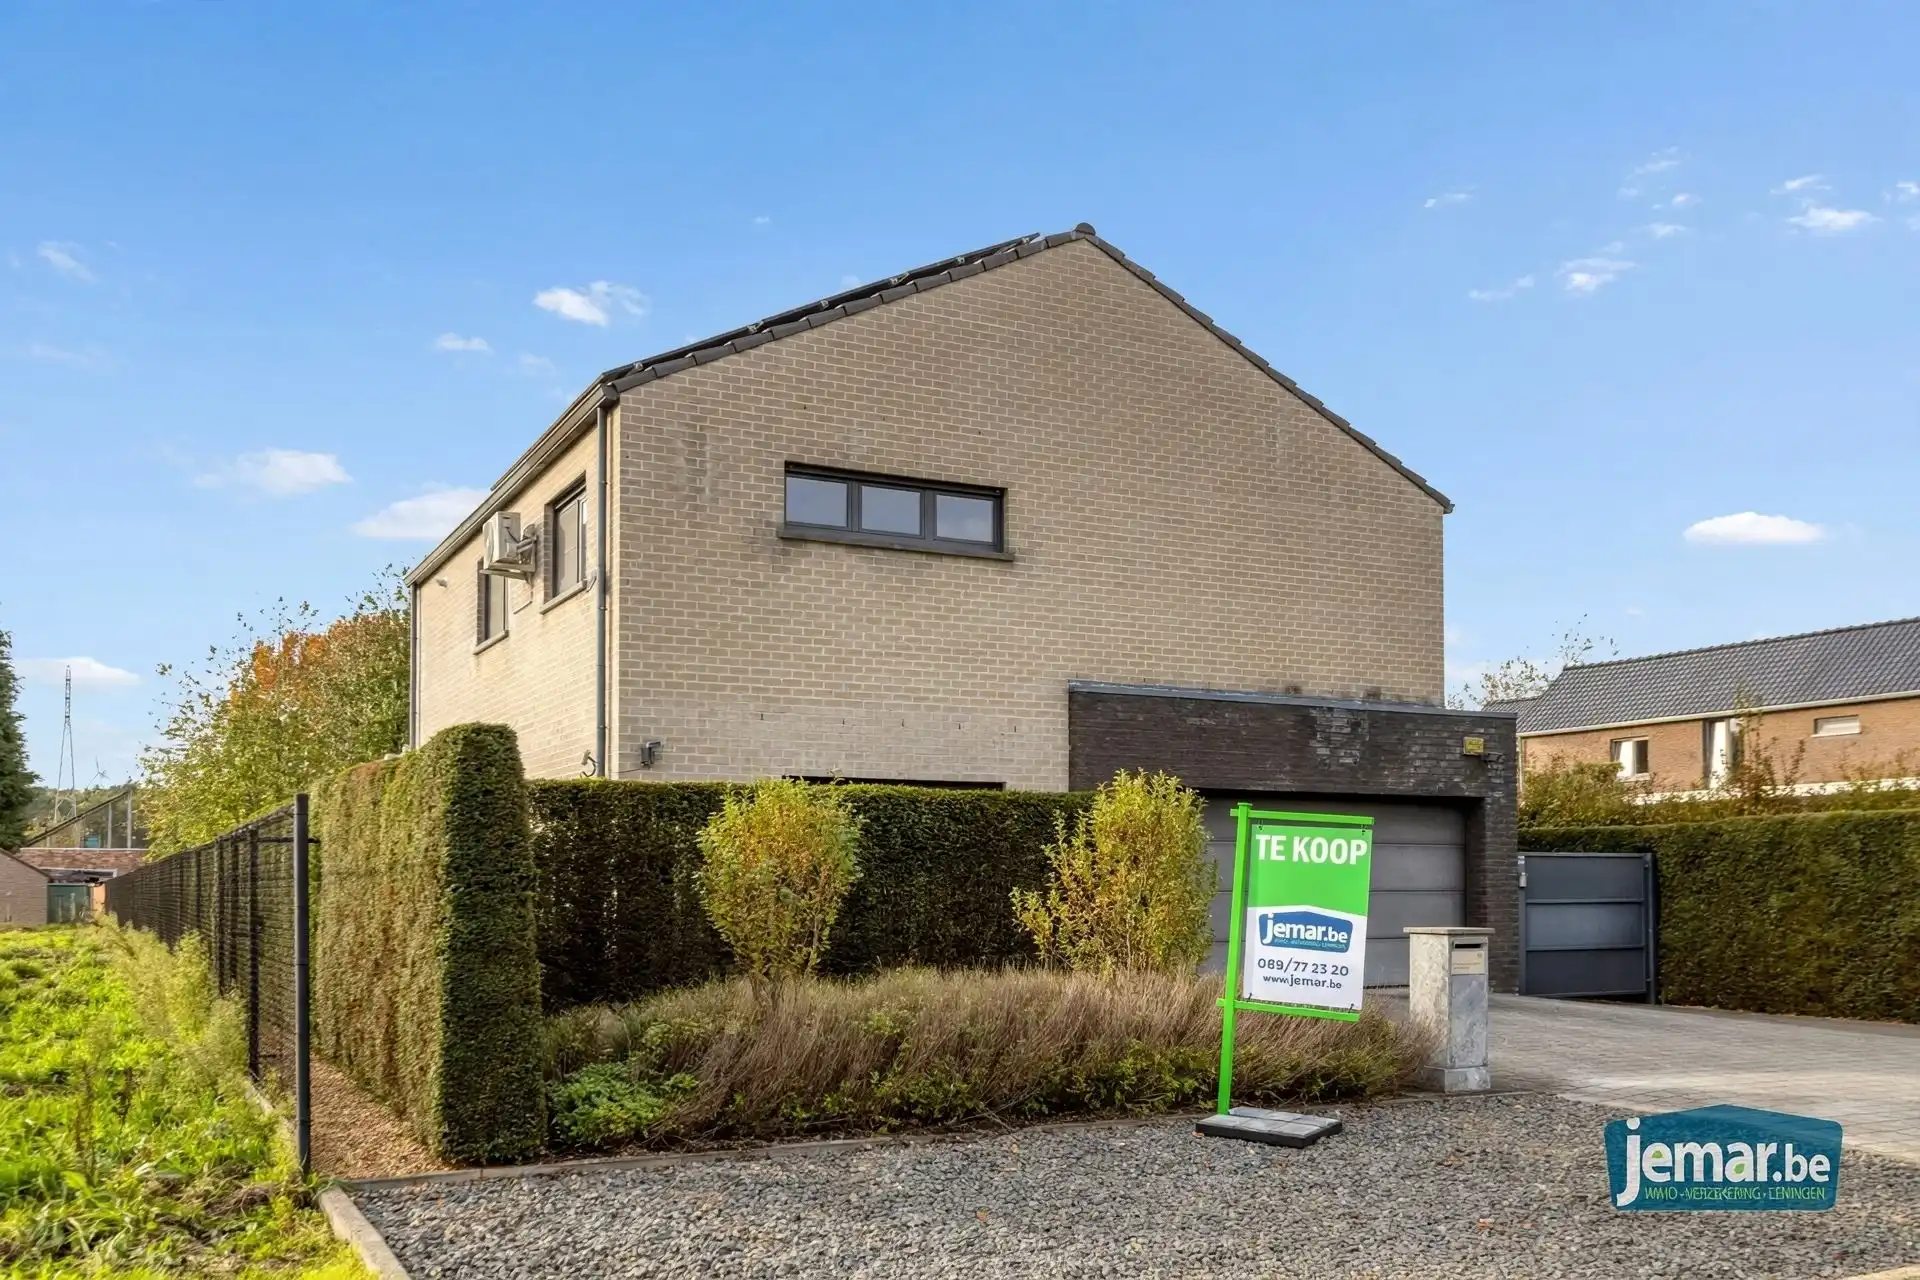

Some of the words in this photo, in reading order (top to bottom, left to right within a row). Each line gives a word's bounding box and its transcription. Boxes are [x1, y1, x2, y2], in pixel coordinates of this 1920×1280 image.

[1256, 834, 1287, 861] TE
[1292, 836, 1368, 865] KOOP
[1262, 912, 1348, 945] jemar.be
[1257, 957, 1309, 973] 089/77
[1311, 963, 1328, 974] 23
[1331, 965, 1349, 976] 20
